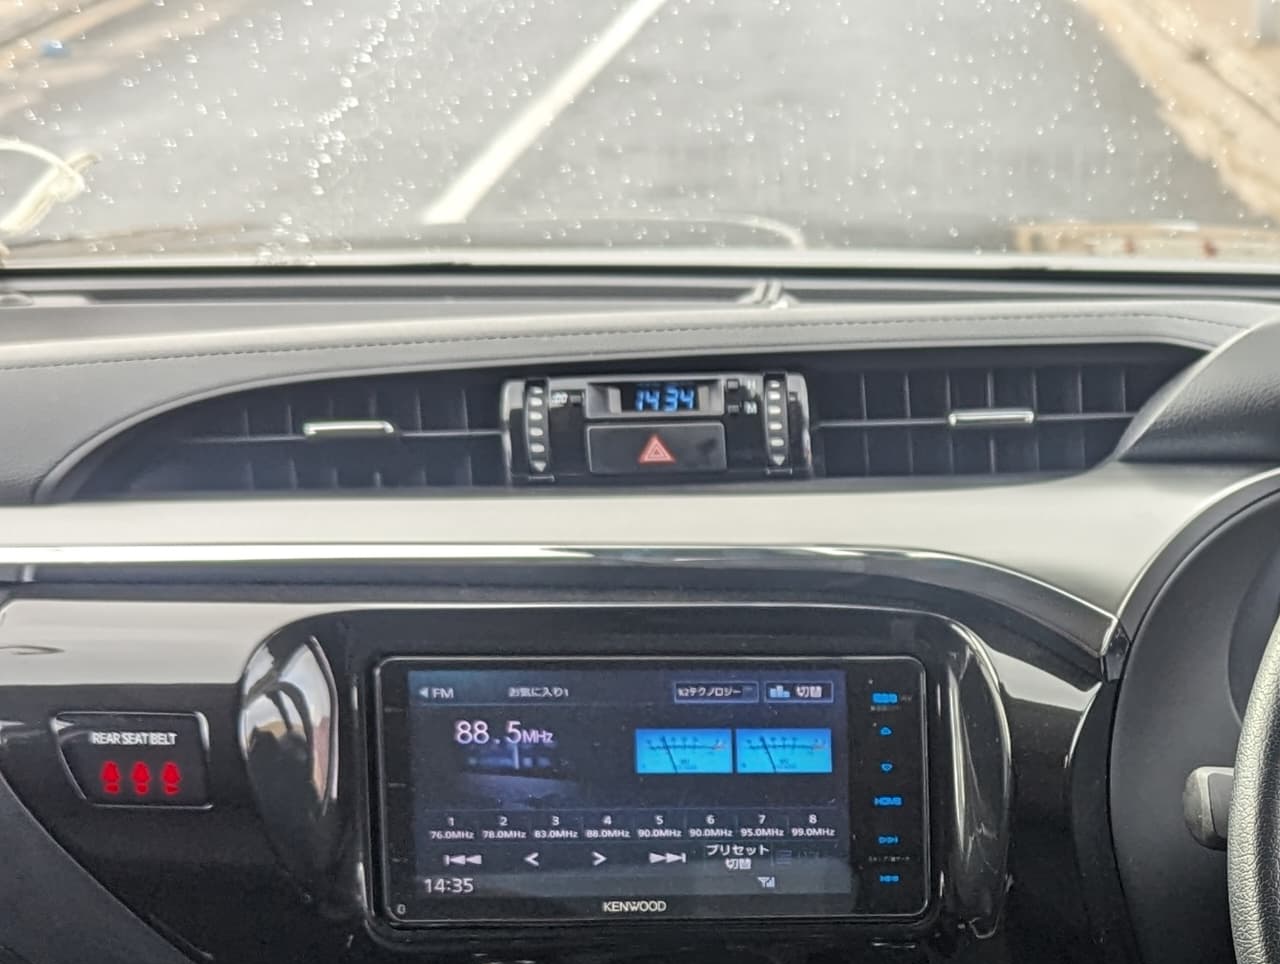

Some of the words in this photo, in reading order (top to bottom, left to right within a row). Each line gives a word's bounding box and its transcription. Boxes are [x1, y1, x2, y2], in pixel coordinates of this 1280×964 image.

[432, 688, 454, 699] FM
[92, 731, 121, 745] REAR
[121, 732, 149, 746] SEAT
[150, 732, 177, 746] BELT
[448, 817, 455, 826] 1
[500, 816, 508, 826] 2
[552, 816, 560, 825] 3
[603, 816, 611, 825] 4
[656, 815, 664, 825] 5
[706, 814, 715, 824] 6
[758, 814, 766, 824] 7
[809, 814, 817, 824] 8
[707, 844, 770, 856] プリセット
[424, 878, 474, 893] 14:35
[603, 901, 667, 912] KENWOOD
